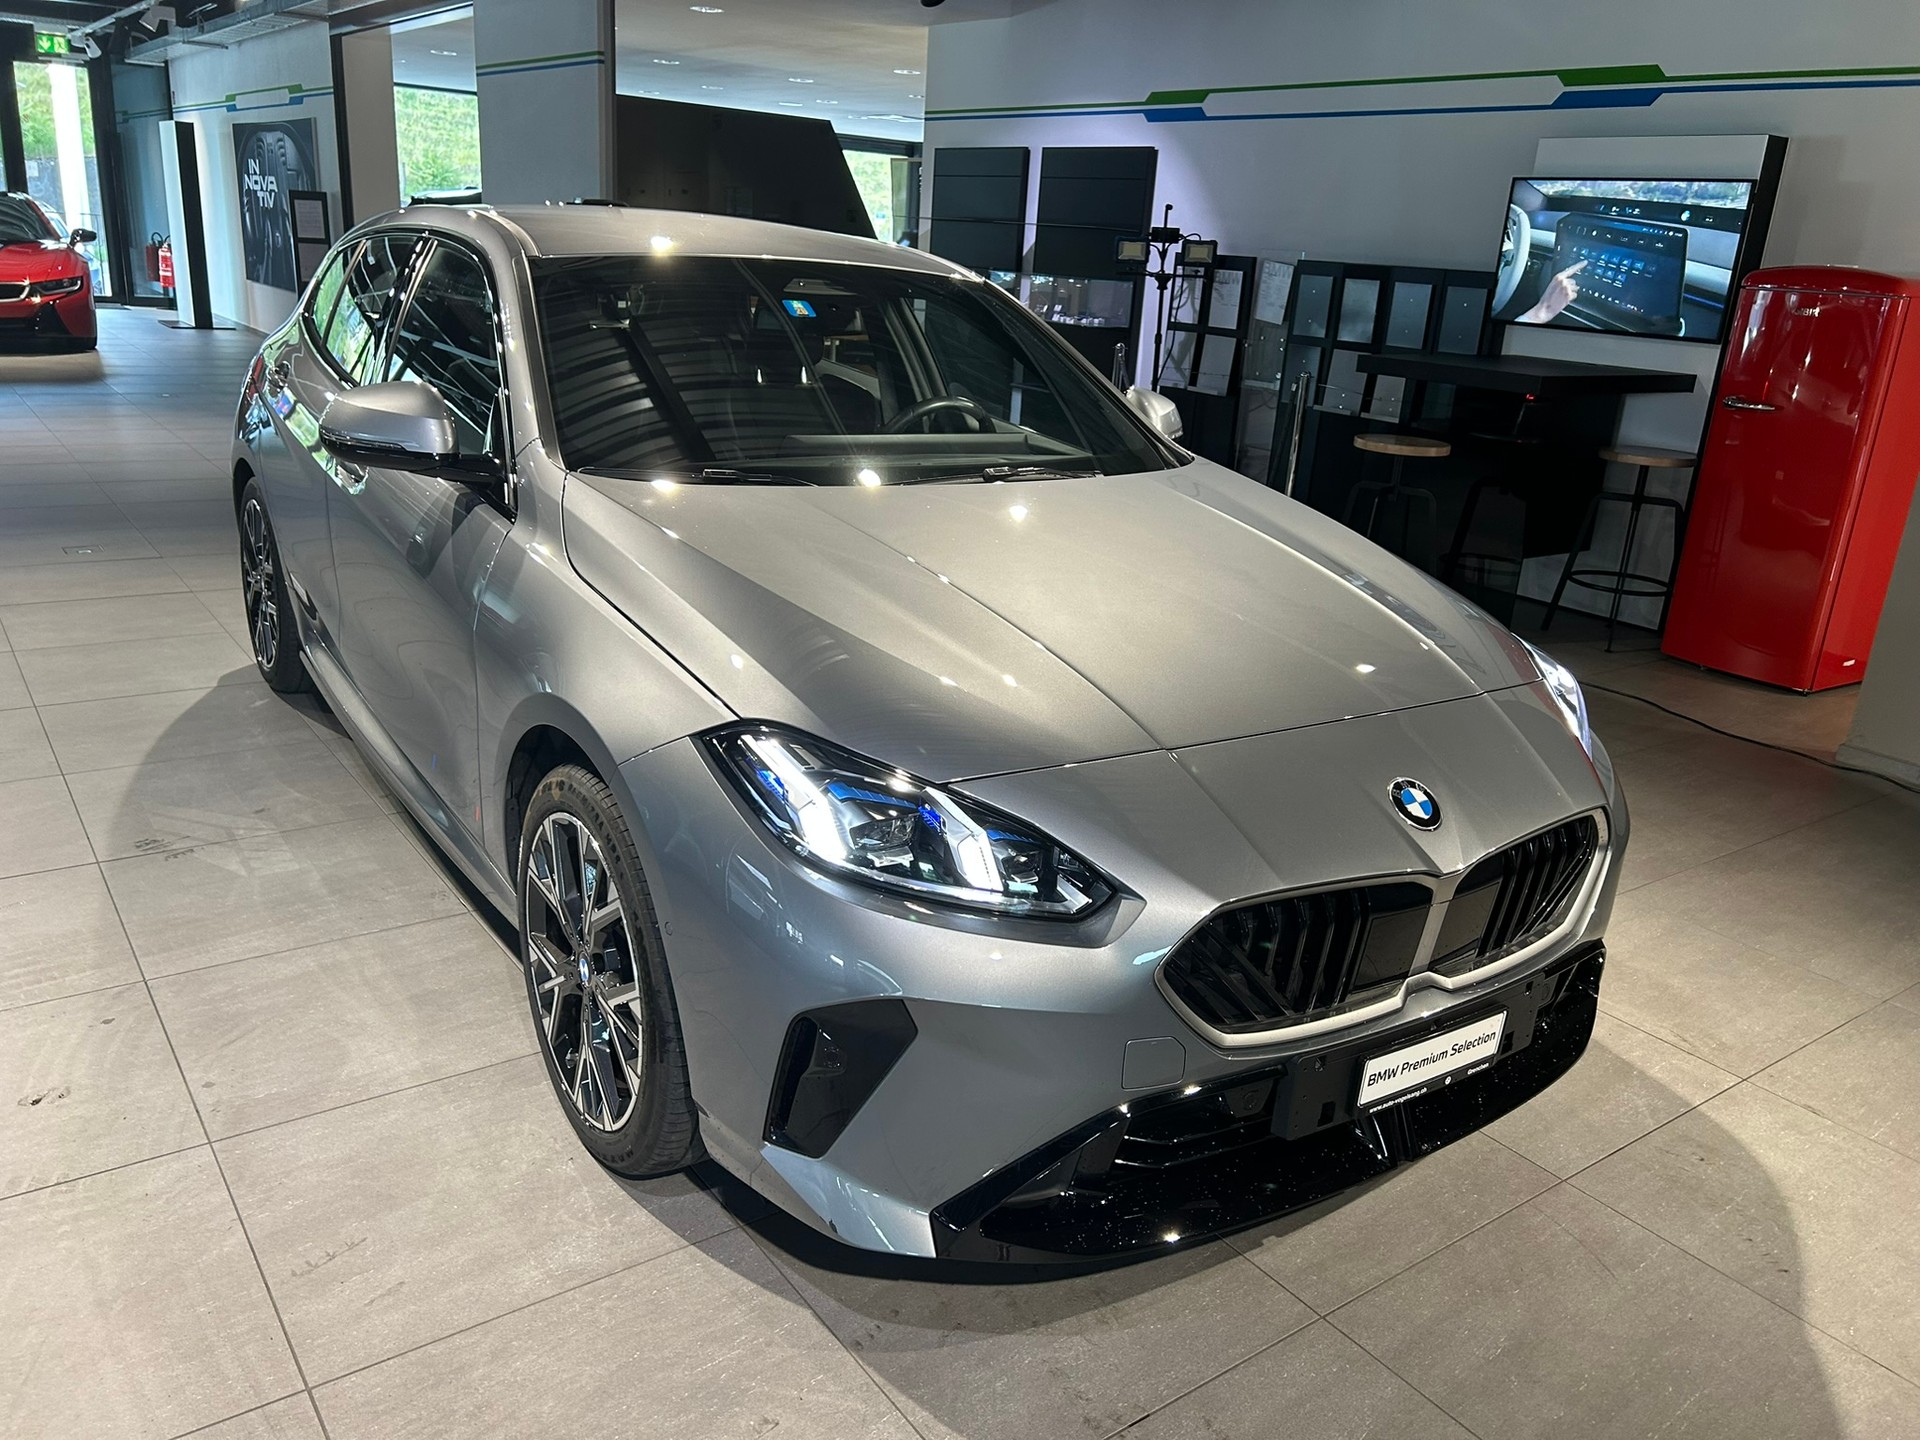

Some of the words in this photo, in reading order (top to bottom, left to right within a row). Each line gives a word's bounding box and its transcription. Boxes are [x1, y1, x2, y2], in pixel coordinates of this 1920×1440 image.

[248, 159, 260, 174] IN
[244, 174, 278, 192] NOVA
[257, 191, 275, 208] TIV
[1367, 1063, 1400, 1087] BMW
[1400, 1049, 1448, 1075] Premium
[1449, 1031, 1496, 1057] Selection
[1369, 1087, 1427, 1113] www.auto-vogelsang.ch
